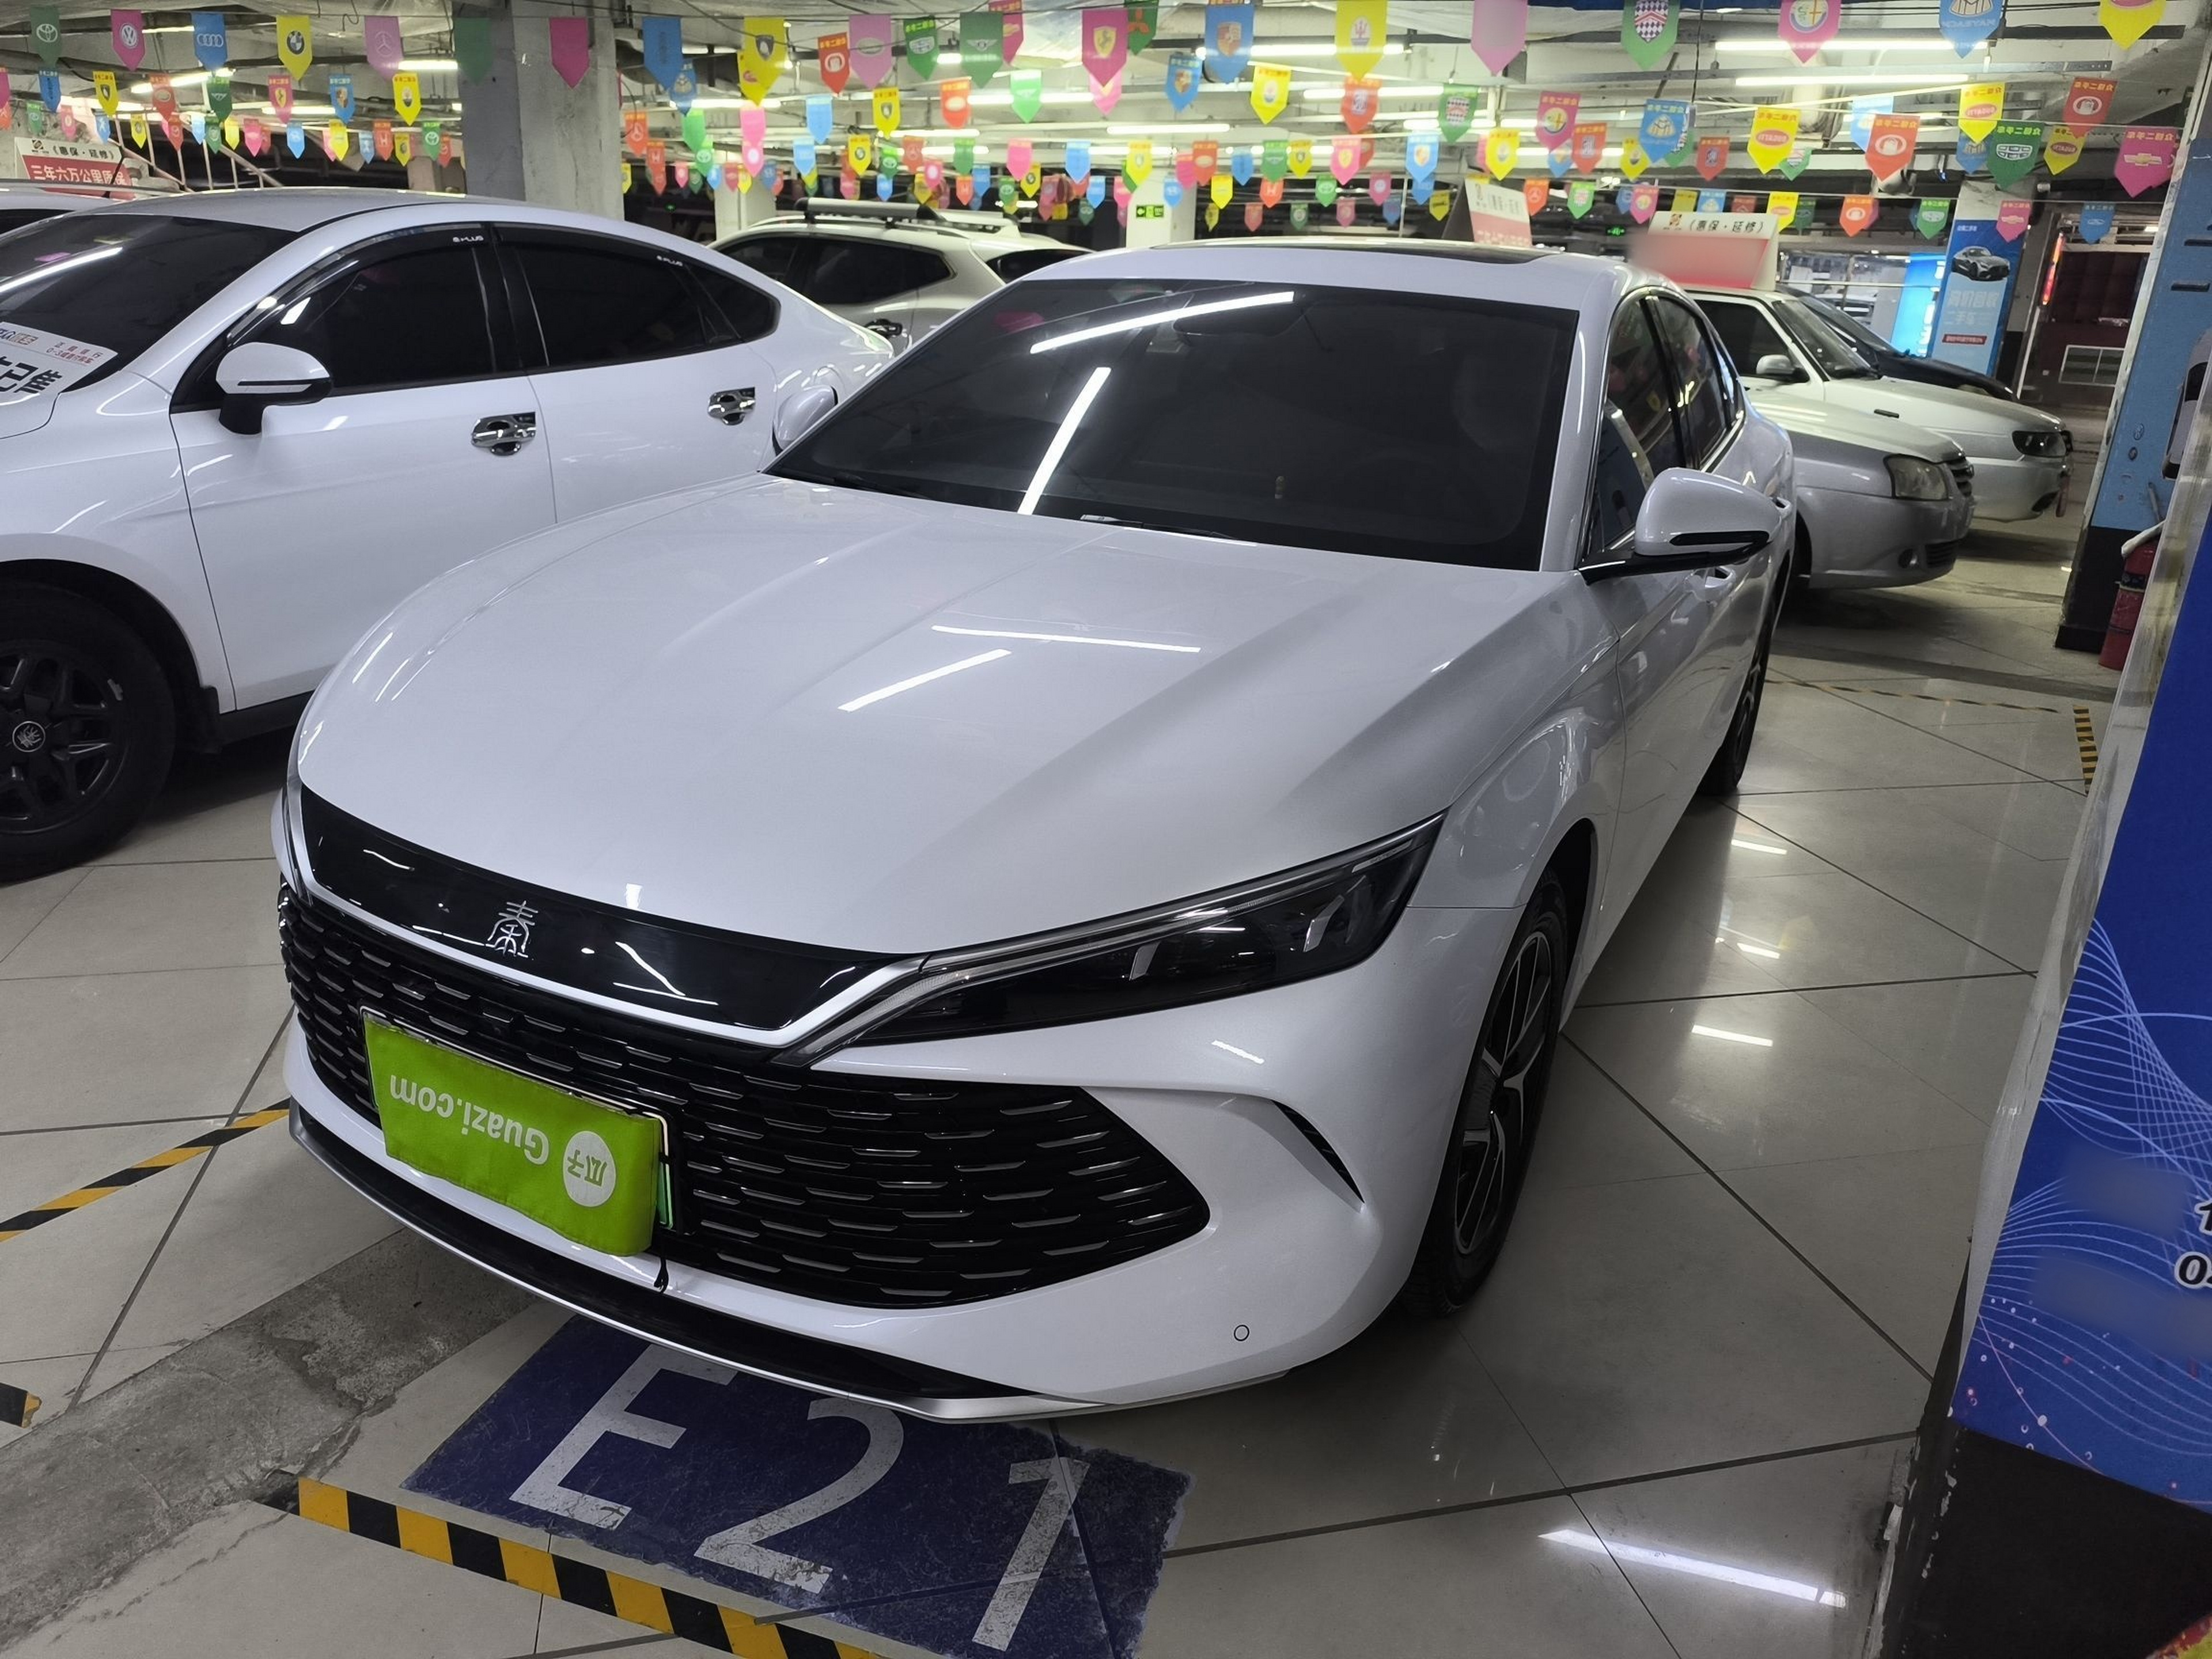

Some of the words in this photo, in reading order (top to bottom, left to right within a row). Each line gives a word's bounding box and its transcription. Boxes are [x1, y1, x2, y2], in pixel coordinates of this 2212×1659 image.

[390, 1074, 550, 1165] Guazi.com
[567, 1149, 608, 1187] 瓜子
[509, 1344, 1091, 1652] E21
